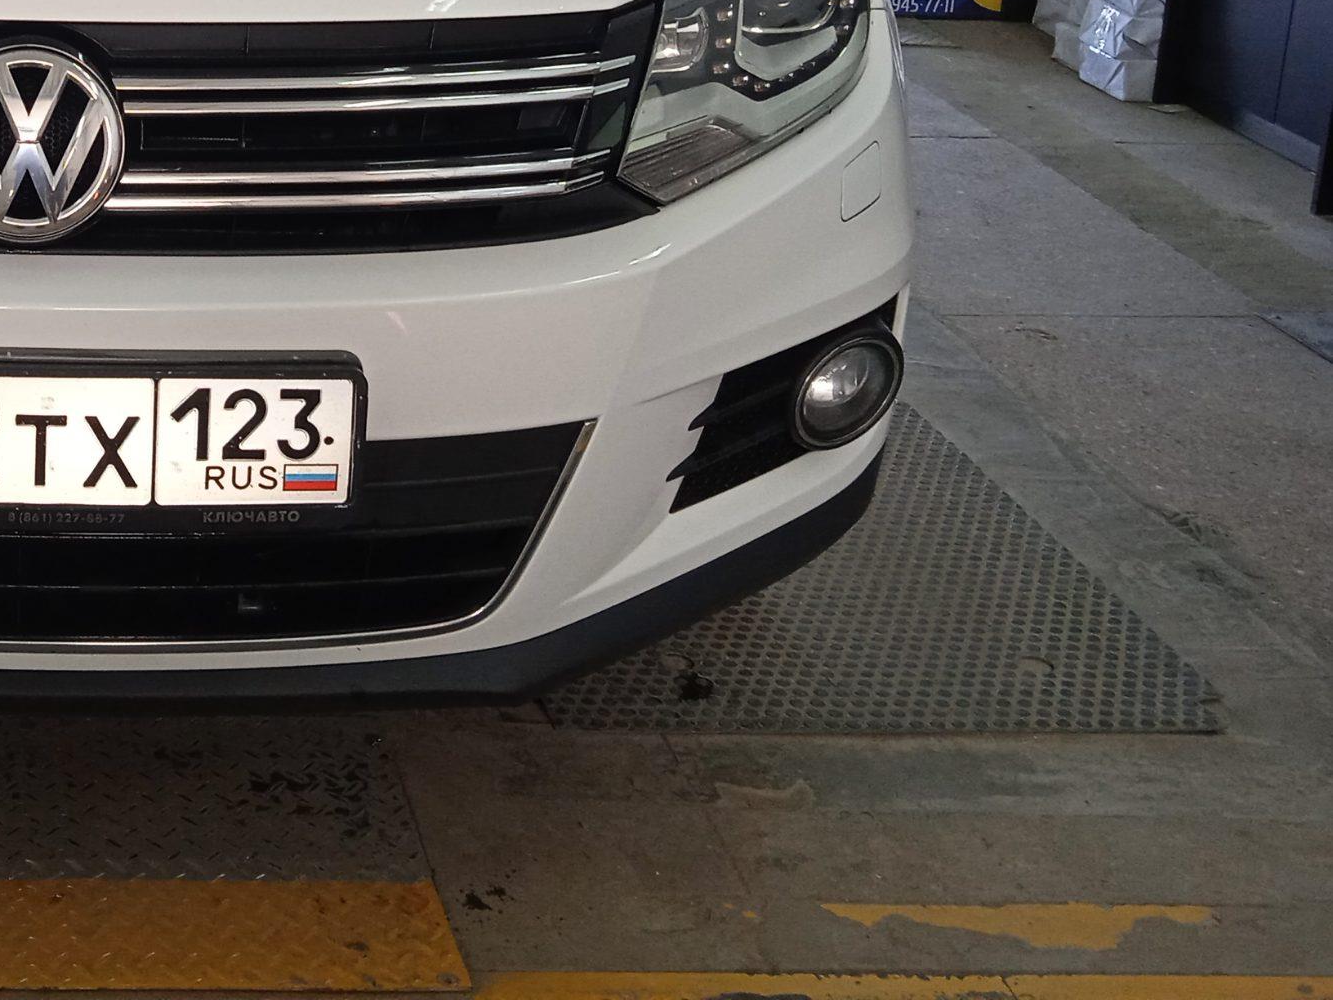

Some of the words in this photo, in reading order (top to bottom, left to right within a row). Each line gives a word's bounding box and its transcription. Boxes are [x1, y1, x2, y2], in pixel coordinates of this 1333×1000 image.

[169, 388, 322, 461] 123
[204, 465, 278, 491] RUS
[202, 510, 301, 523] КЛЮЧАВТО
